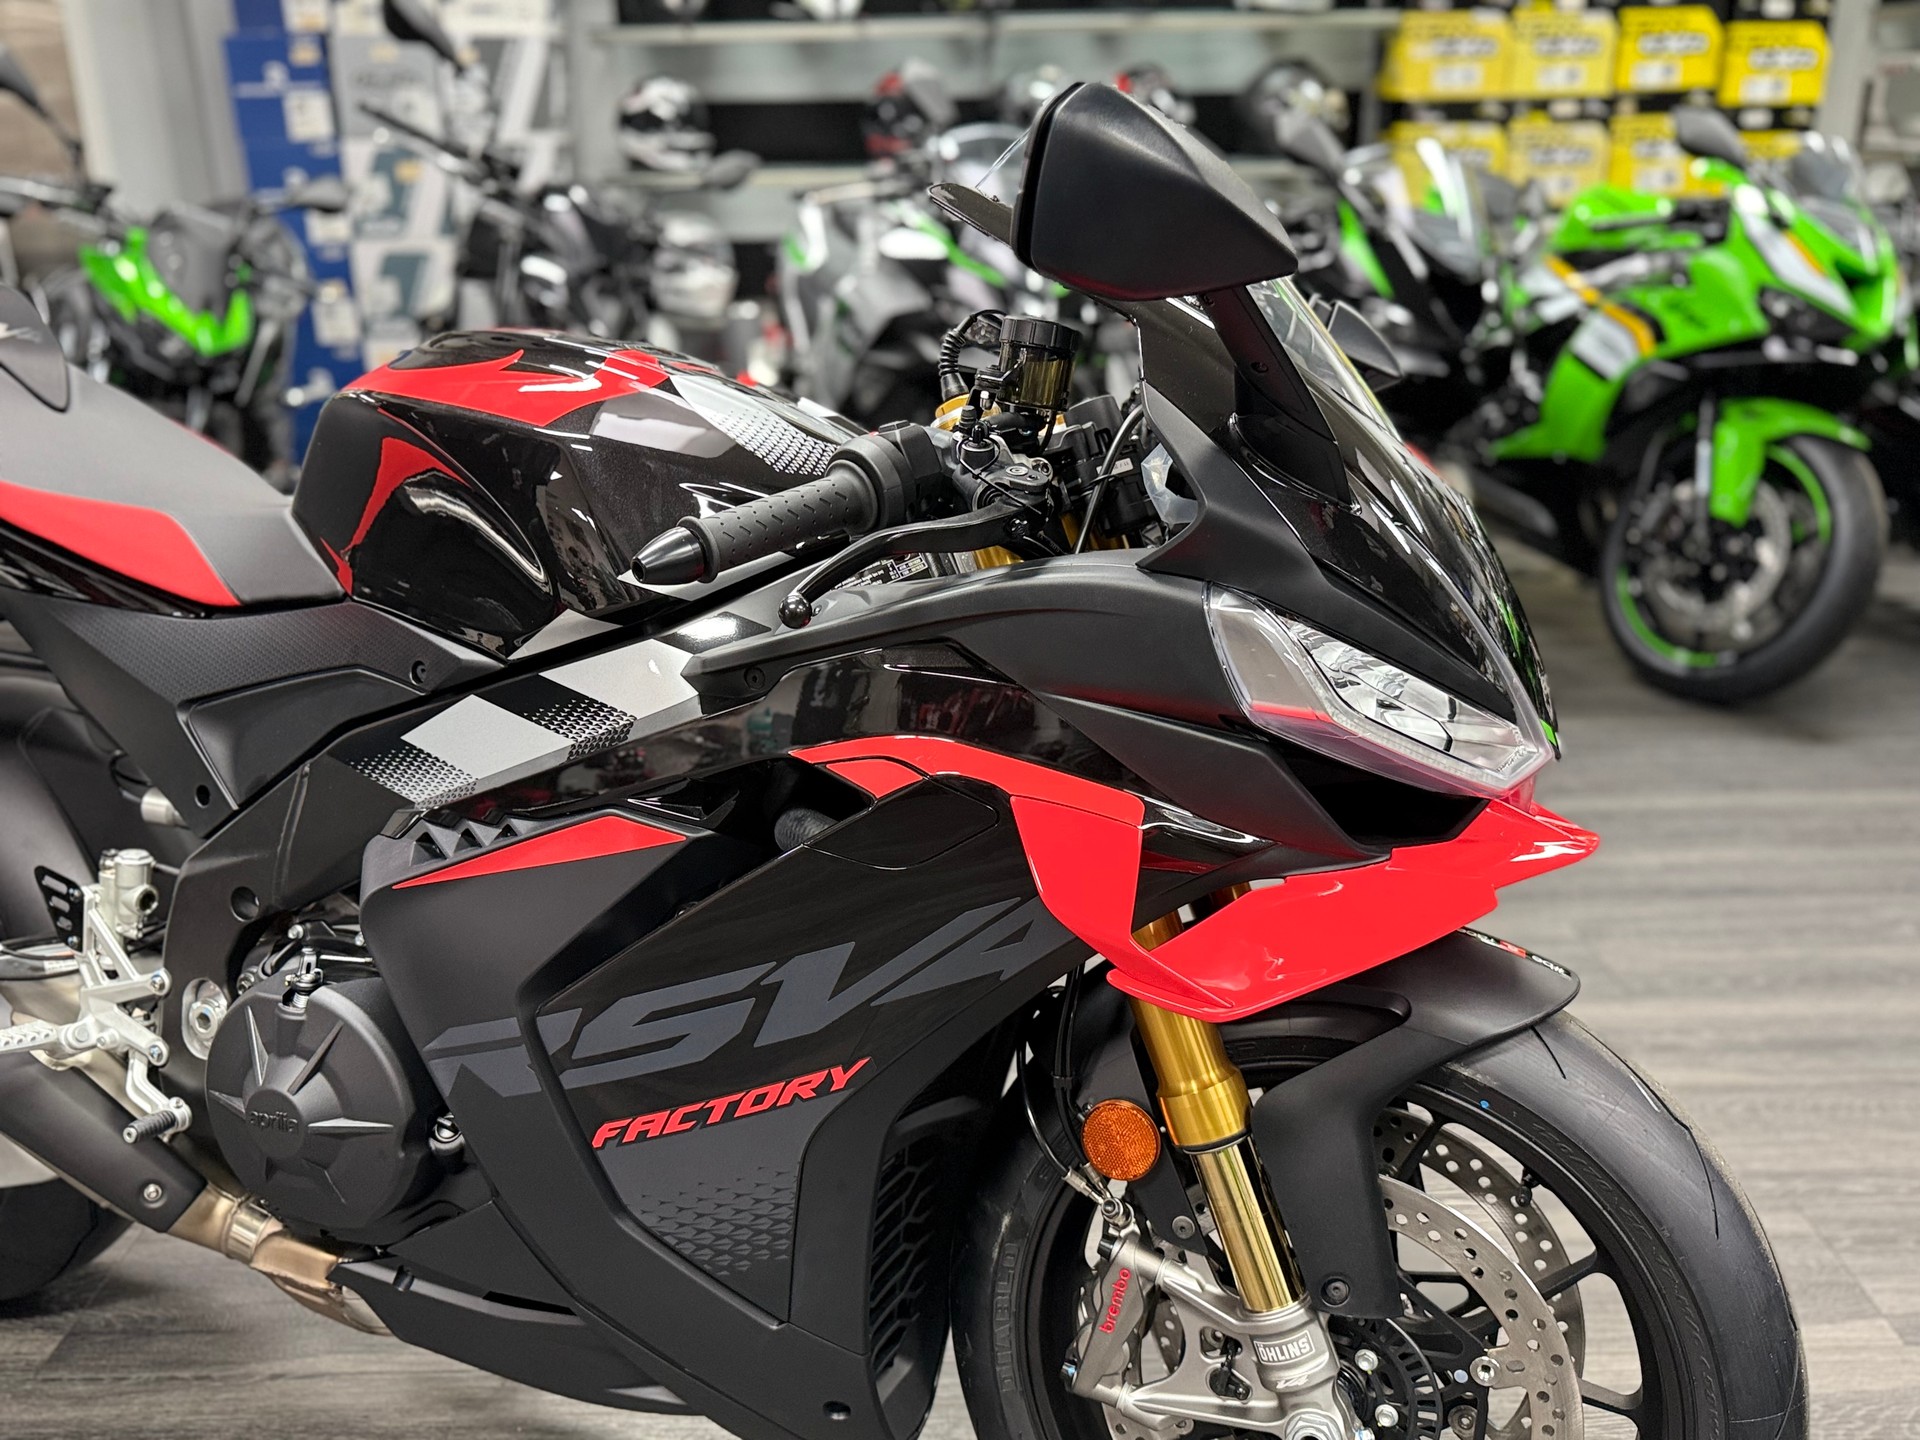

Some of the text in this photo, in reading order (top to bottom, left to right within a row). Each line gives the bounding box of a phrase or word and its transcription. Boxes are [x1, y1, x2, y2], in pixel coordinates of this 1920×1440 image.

[423, 895, 1077, 1098] RSV4
[250, 1110, 299, 1133] aprilia
[592, 1055, 872, 1148] FACTORY
[993, 1241, 1020, 1392] DIABLO
[1098, 1267, 1132, 1334] brembo
[1257, 1337, 1311, 1362] ÖHLINS
